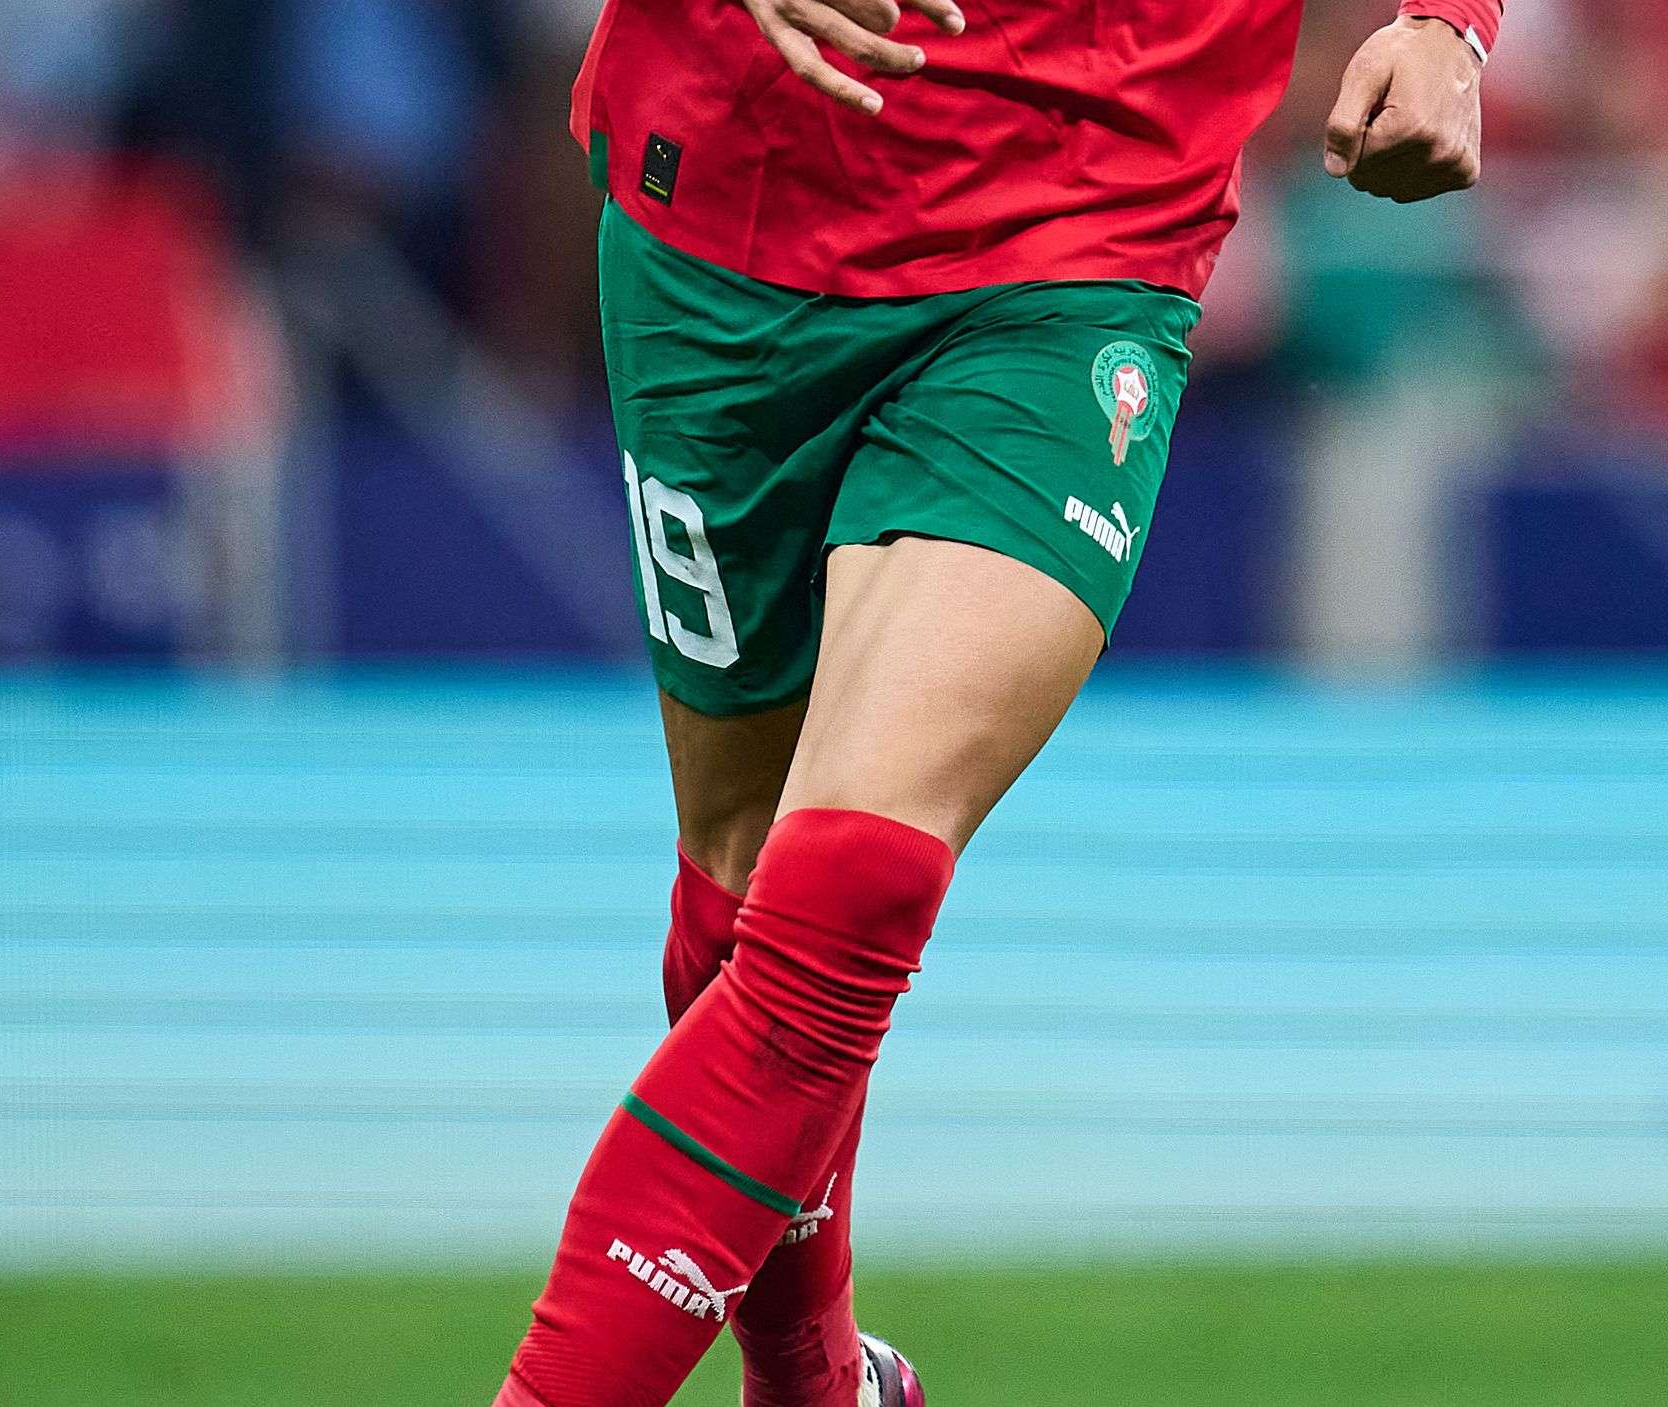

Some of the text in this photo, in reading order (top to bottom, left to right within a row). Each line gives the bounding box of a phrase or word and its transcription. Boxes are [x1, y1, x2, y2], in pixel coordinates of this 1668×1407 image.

[624, 449, 740, 668] 19
[1064, 495, 1126, 563] PUMA
[606, 1238, 711, 1319] PUMA
